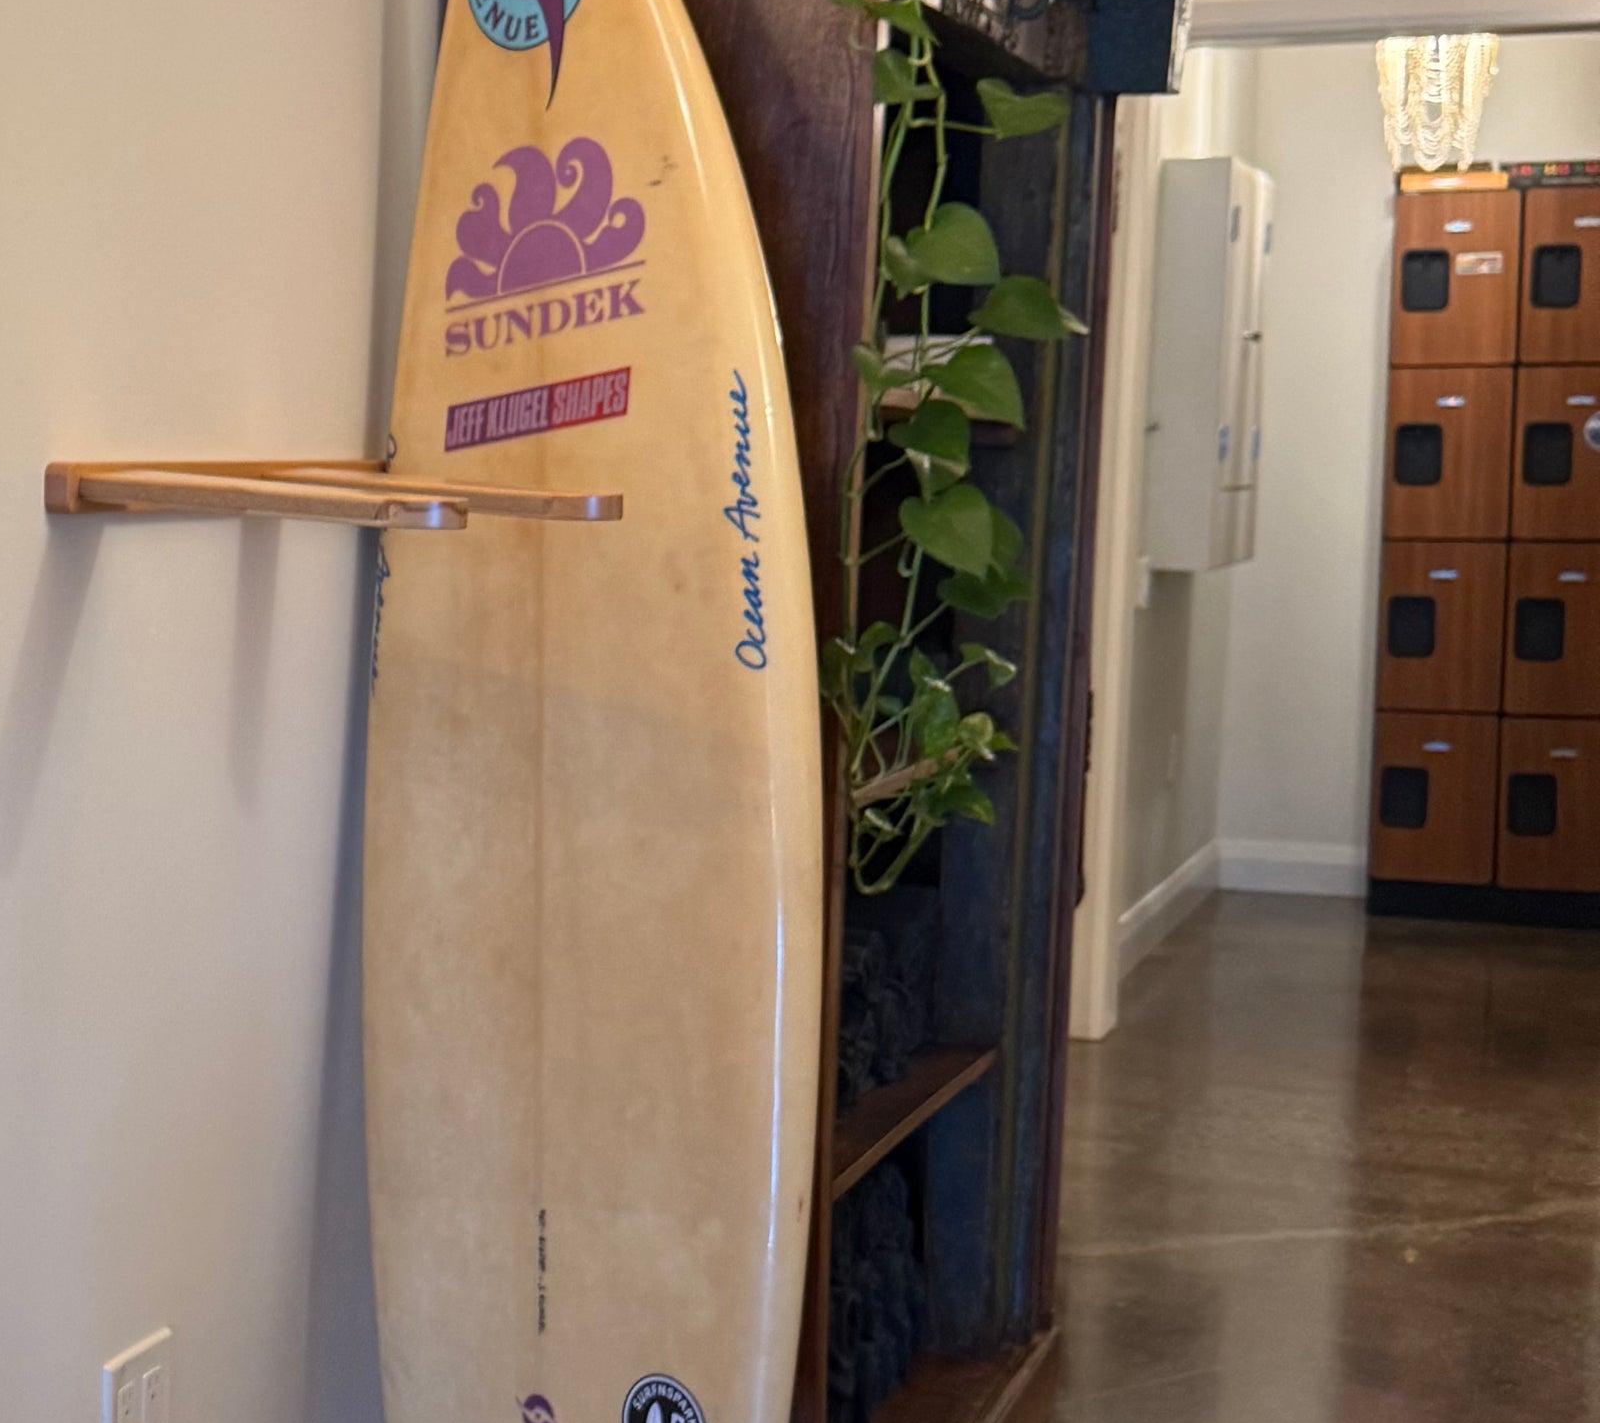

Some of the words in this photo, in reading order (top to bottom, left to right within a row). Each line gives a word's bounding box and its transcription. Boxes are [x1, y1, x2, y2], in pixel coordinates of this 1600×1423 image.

[445, 279, 644, 357] SUNDEK
[450, 402, 486, 447] JEFF
[486, 387, 550, 438] KLUGEL
[552, 372, 627, 426] SHAPES
[723, 368, 761, 543] Avenue
[735, 551, 768, 671] Ocean
